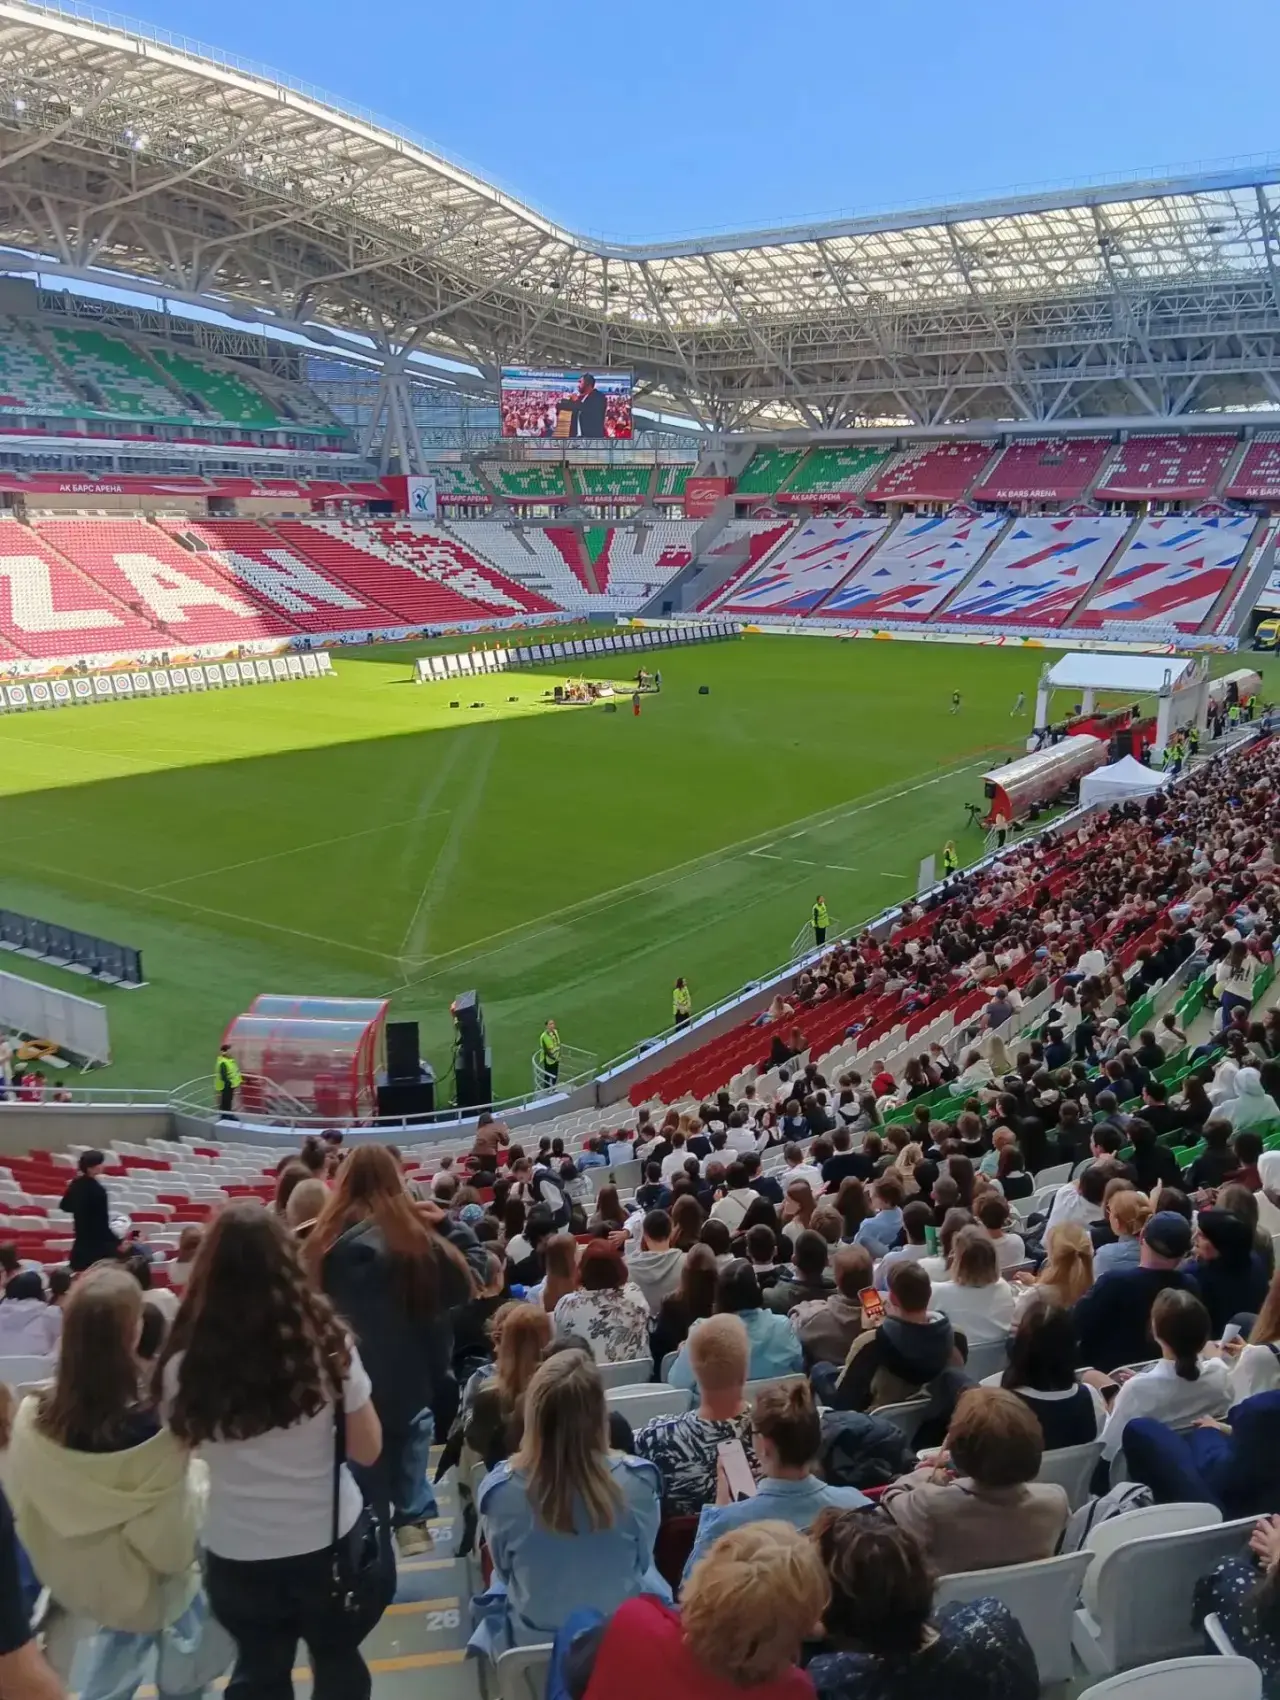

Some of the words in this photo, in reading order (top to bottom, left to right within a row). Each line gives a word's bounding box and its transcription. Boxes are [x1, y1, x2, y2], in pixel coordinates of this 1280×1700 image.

[60, 484, 71, 492] АК
[72, 484, 94, 493] БАРС
[95, 484, 122, 493] АРЕНА
[1260, 488, 1280, 496] БАР
[818, 493, 841, 501] АРЕНА
[997, 489, 1007, 498] AK
[1008, 489, 1028, 498] BARS
[1029, 489, 1056, 497] ARENA
